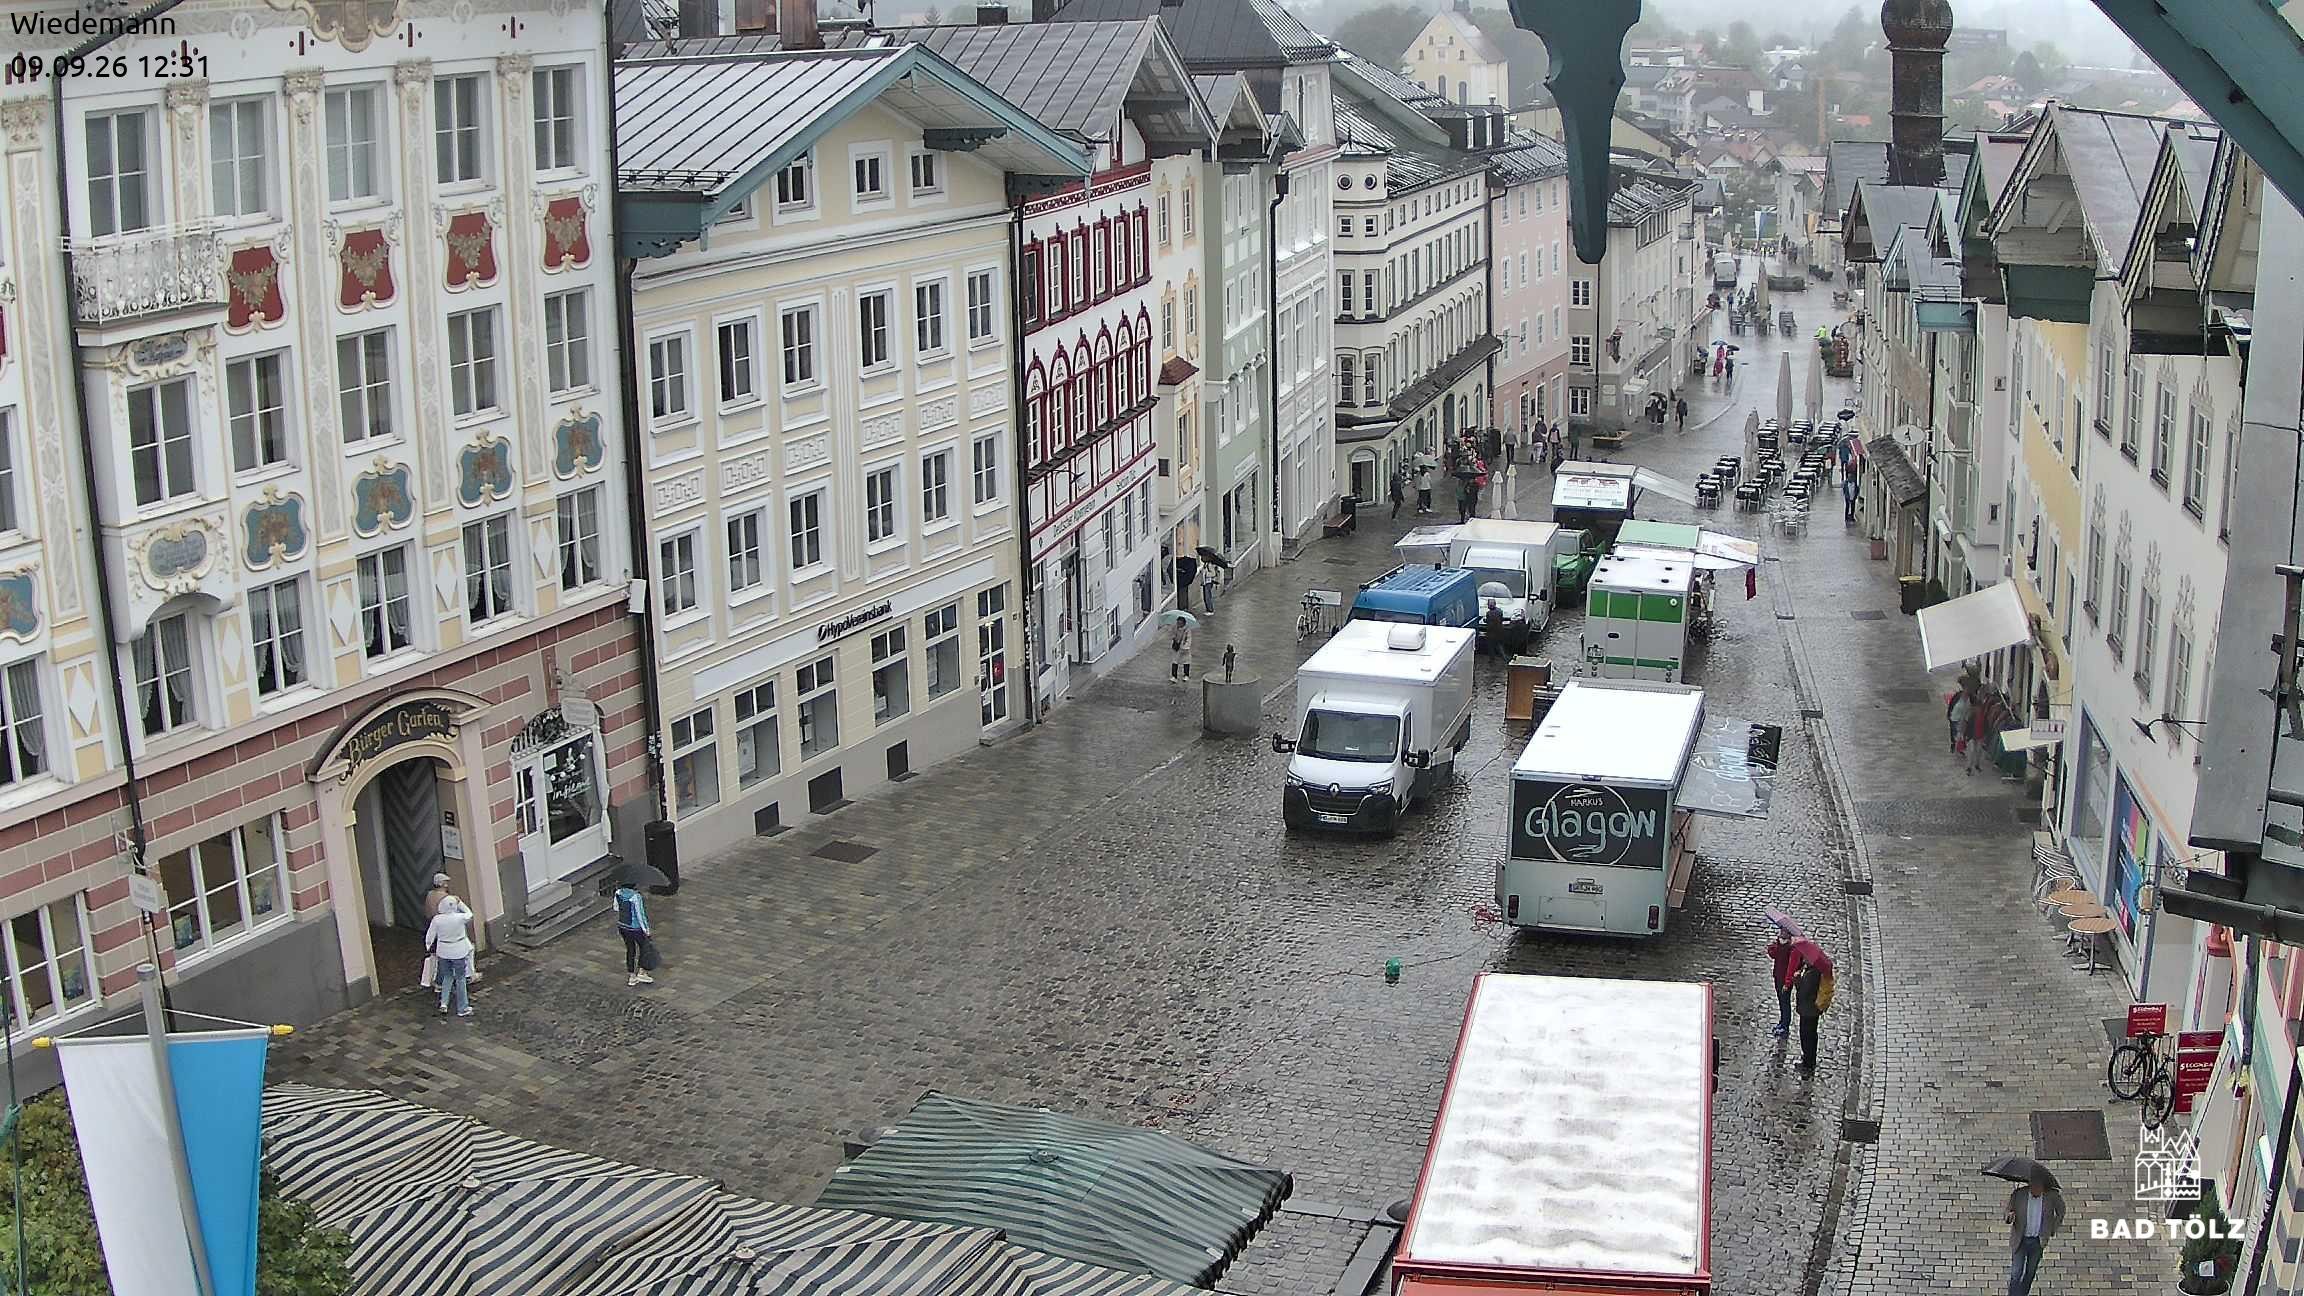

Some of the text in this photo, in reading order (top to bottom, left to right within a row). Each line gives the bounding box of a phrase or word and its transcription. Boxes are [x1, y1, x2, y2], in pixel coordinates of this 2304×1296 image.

[348, 721, 394, 767] Bürger
[1570, 797, 1604, 807] MARKUS
[1525, 801, 1656, 857] Glagow
